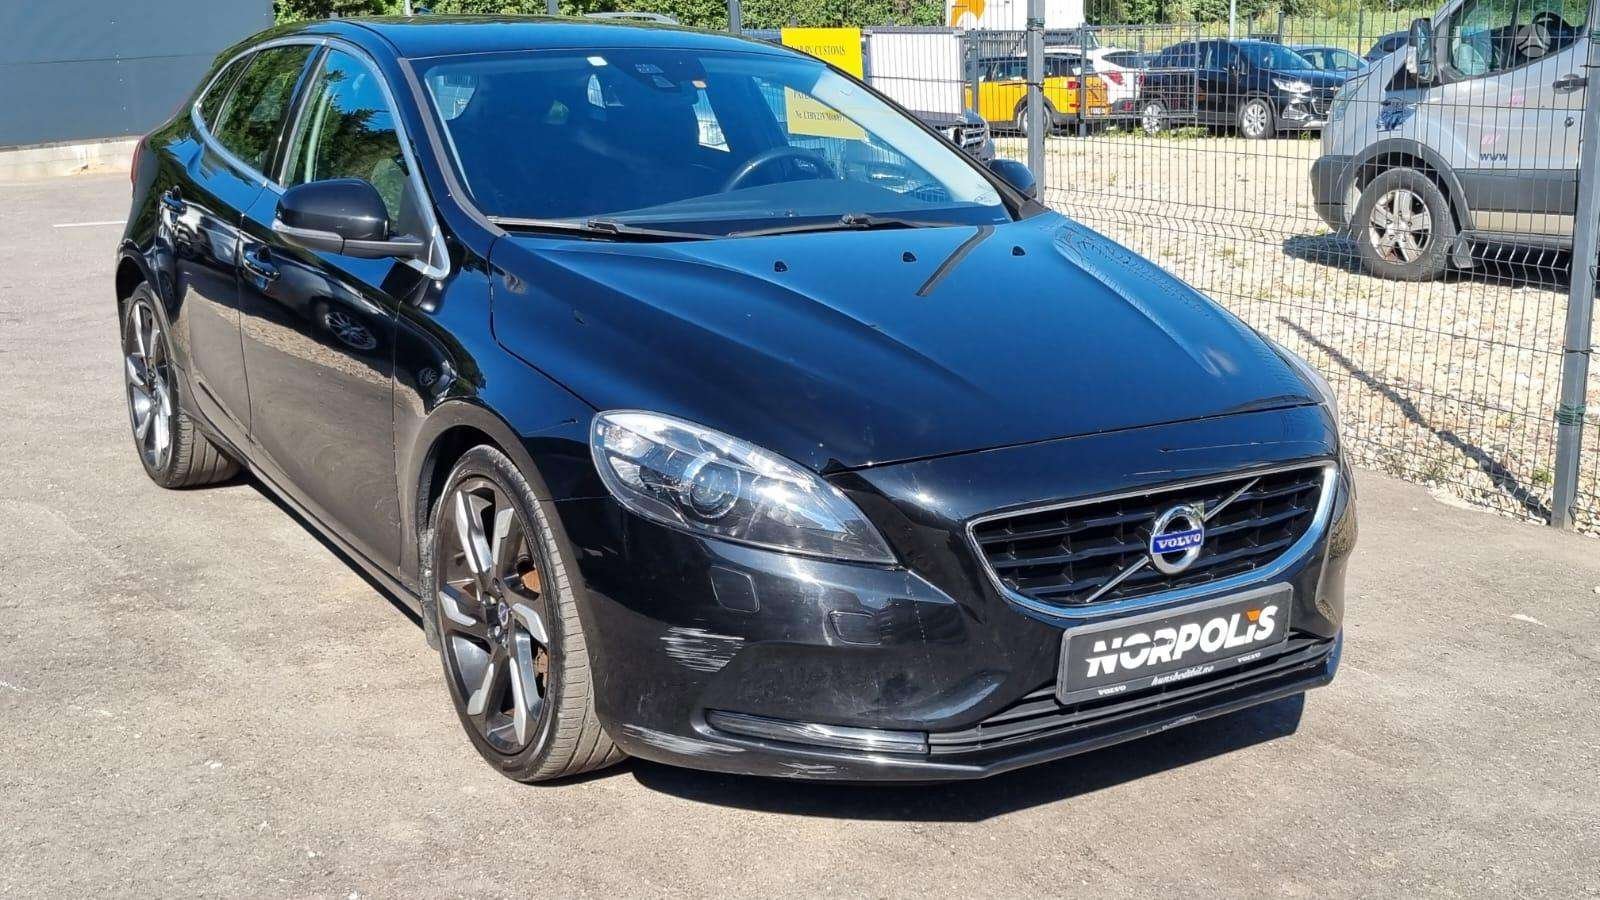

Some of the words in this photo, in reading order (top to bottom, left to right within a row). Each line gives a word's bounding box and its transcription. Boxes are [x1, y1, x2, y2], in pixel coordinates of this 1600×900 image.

[815, 45, 846, 56] CUSTOMS
[1156, 533, 1201, 549] VOLVO
[1098, 685, 1127, 696] VOLVO
